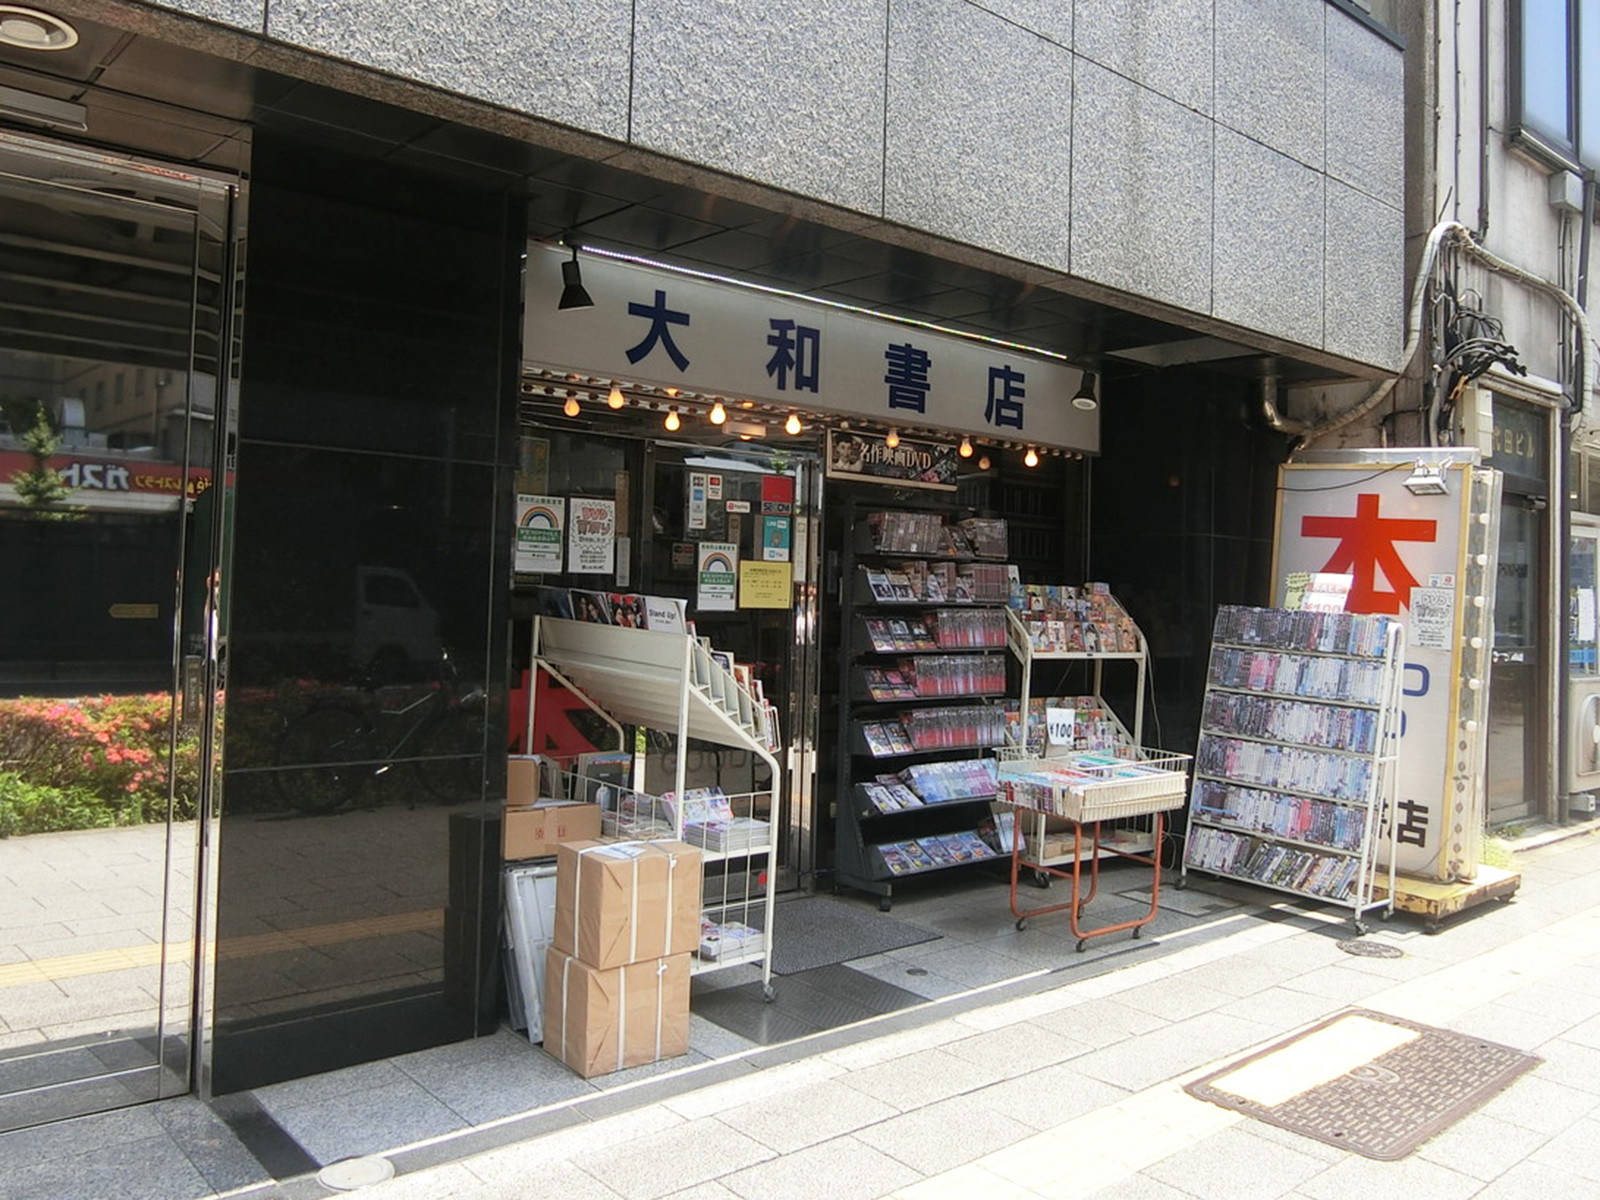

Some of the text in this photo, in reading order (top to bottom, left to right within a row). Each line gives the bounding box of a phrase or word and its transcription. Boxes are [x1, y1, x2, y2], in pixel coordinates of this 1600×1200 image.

[625, 288, 1026, 431] 大和書店
[859, 442, 931, 470] 名作映画DVD
[1301, 493, 1437, 616] 本
[1050, 721, 1073, 738] ¥100
